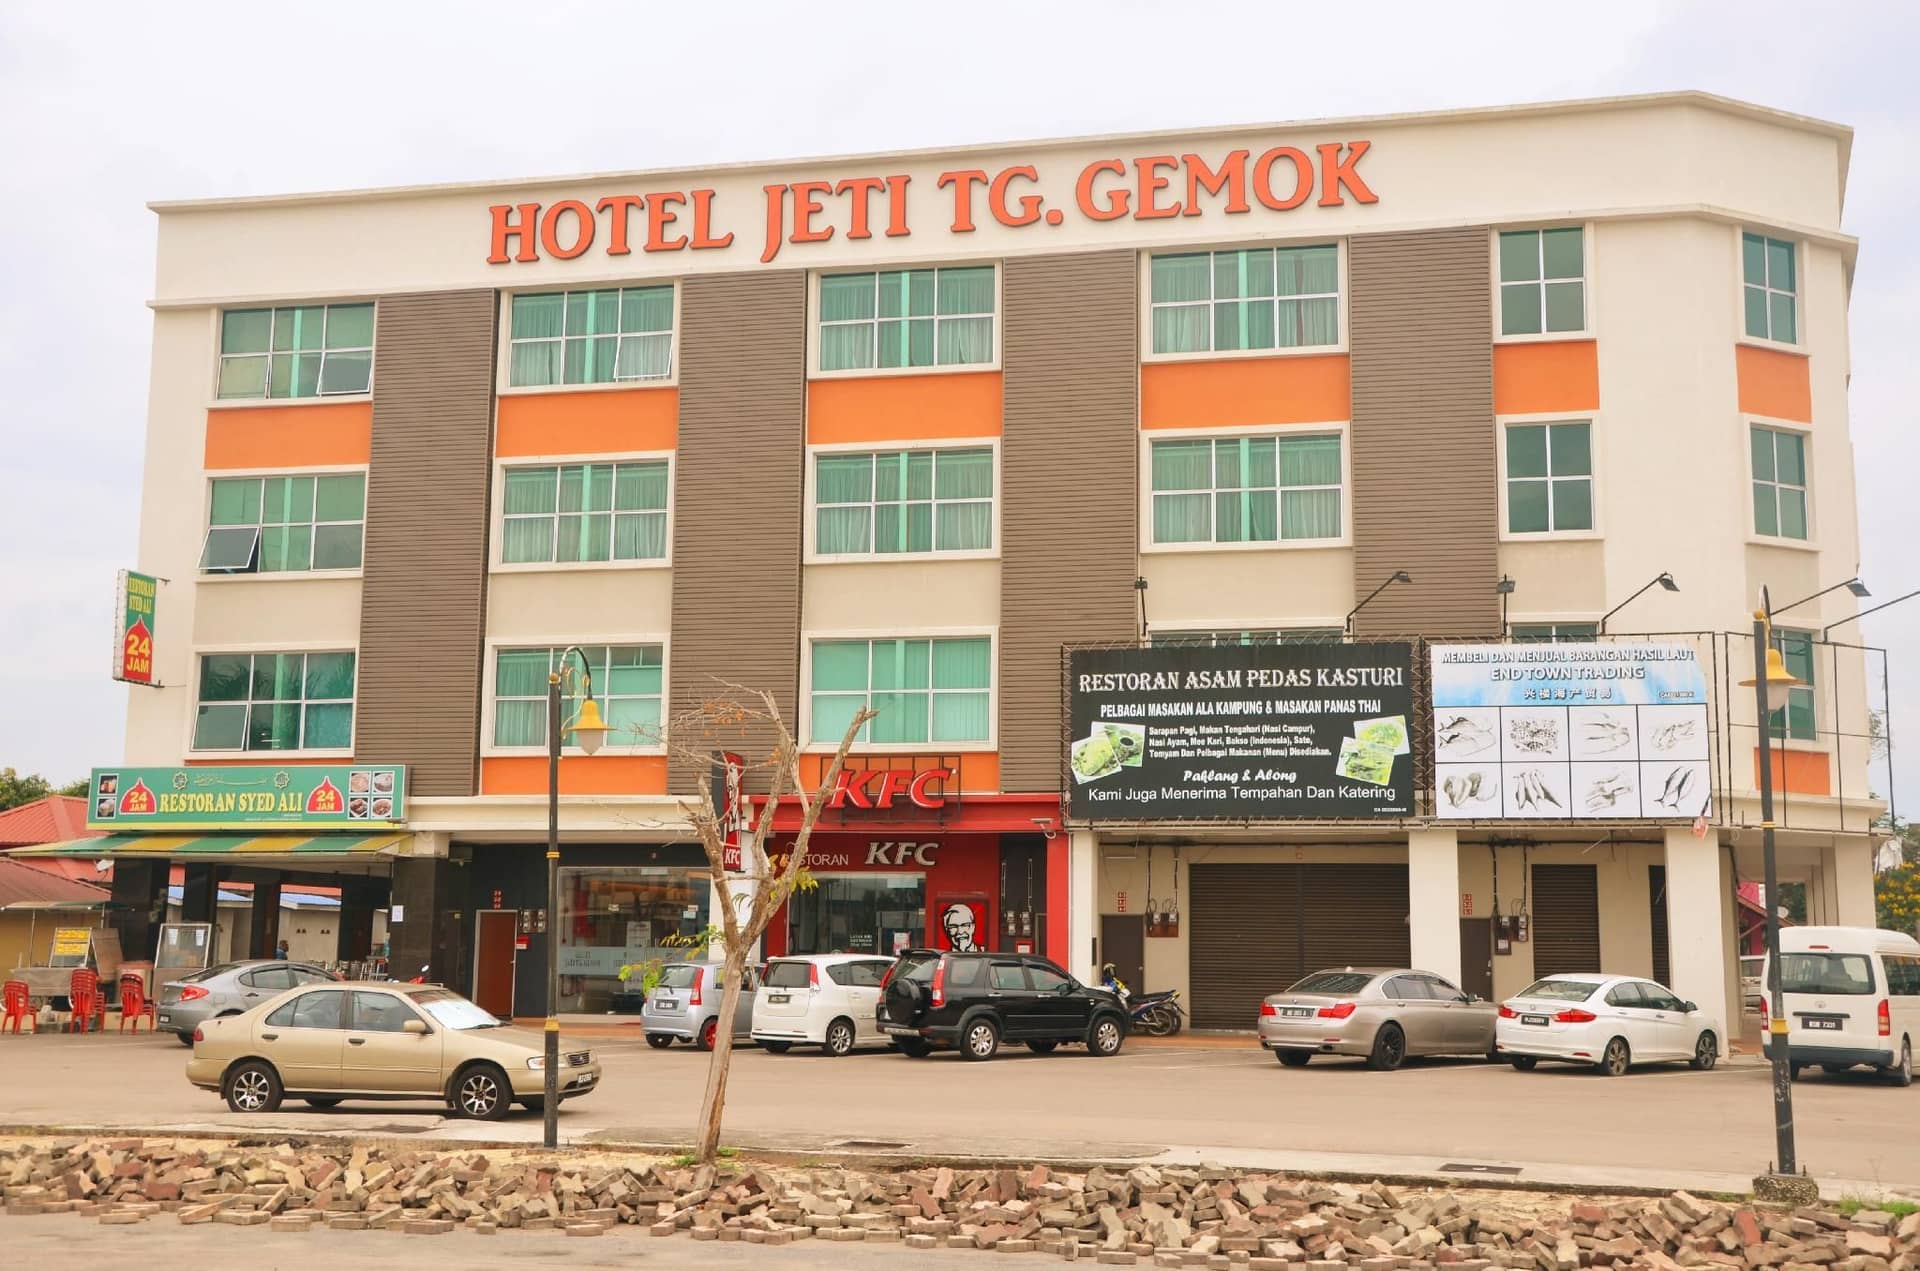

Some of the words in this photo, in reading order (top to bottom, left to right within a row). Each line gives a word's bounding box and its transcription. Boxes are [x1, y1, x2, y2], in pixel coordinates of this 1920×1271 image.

[487, 189, 734, 265] HOTEL
[760, 175, 911, 263] JETI
[937, 165, 1064, 233] TG.
[1075, 140, 1379, 221] GEMOK
[127, 634, 151, 657] 24
[1442, 651, 1490, 663] MEMBELI
[1491, 651, 1516, 662] DAN
[1518, 651, 1567, 662] MENJUAL
[1569, 649, 1630, 661] BARANGAN
[1633, 648, 1665, 661] HASIL
[1666, 648, 1695, 660] LAUT
[127, 656, 149, 673] JAM
[1079, 672, 1180, 692] RESTORAN
[1184, 670, 1242, 690] ASAM
[1246, 669, 1312, 688] PEDAS
[1316, 667, 1404, 687] KASTURI
[1491, 667, 1523, 681] END
[1524, 667, 1573, 680] TOWN
[1575, 666, 1645, 679] TRADING
[1100, 704, 1145, 718] PELBAGAI
[1148, 702, 1194, 717] MASAKAN
[1195, 702, 1215, 716] ALA
[1216, 701, 1263, 716] KAMPUNG
[1265, 701, 1272, 714] &
[1275, 700, 1321, 714] MASAKAN
[1324, 700, 1356, 713] PANAS
[1358, 699, 1381, 713] THAI
[1149, 727, 1178, 736] Sarapan
[1179, 726, 1198, 736] Pagi,
[1199, 725, 1223, 734] Makan
[1224, 724, 1261, 735] Tengahari
[1261, 725, 1281, 735] (Nasi
[1149, 738, 1166, 747] Nasi
[1167, 737, 1189, 748] Ayam,
[1226, 736, 1248, 745] Bakso
[1149, 749, 1179, 759] Tomyam
[1181, 749, 1195, 757] Dan
[1242, 770, 1251, 781] &
[1255, 769, 1297, 783] Along
[315, 790, 335, 802] 24
[826, 768, 951, 809] KFC
[1088, 788, 1122, 801] Kami
[1125, 788, 1157, 802] Juga
[1161, 787, 1226, 799] Menerima
[1231, 786, 1302, 801] Tempahan
[1306, 787, 1334, 798] Dan
[1338, 786, 1396, 801] Katering
[129, 791, 148, 803] 24
[159, 793, 236, 813] RESTORAN
[238, 792, 276, 812] SYED
[277, 792, 303, 812] ALI
[129, 803, 147, 812] JAM
[315, 802, 335, 811] JAM
[724, 848, 740, 865] KFC
[782, 854, 849, 866] RSTORAN
[864, 842, 939, 866] KFC
